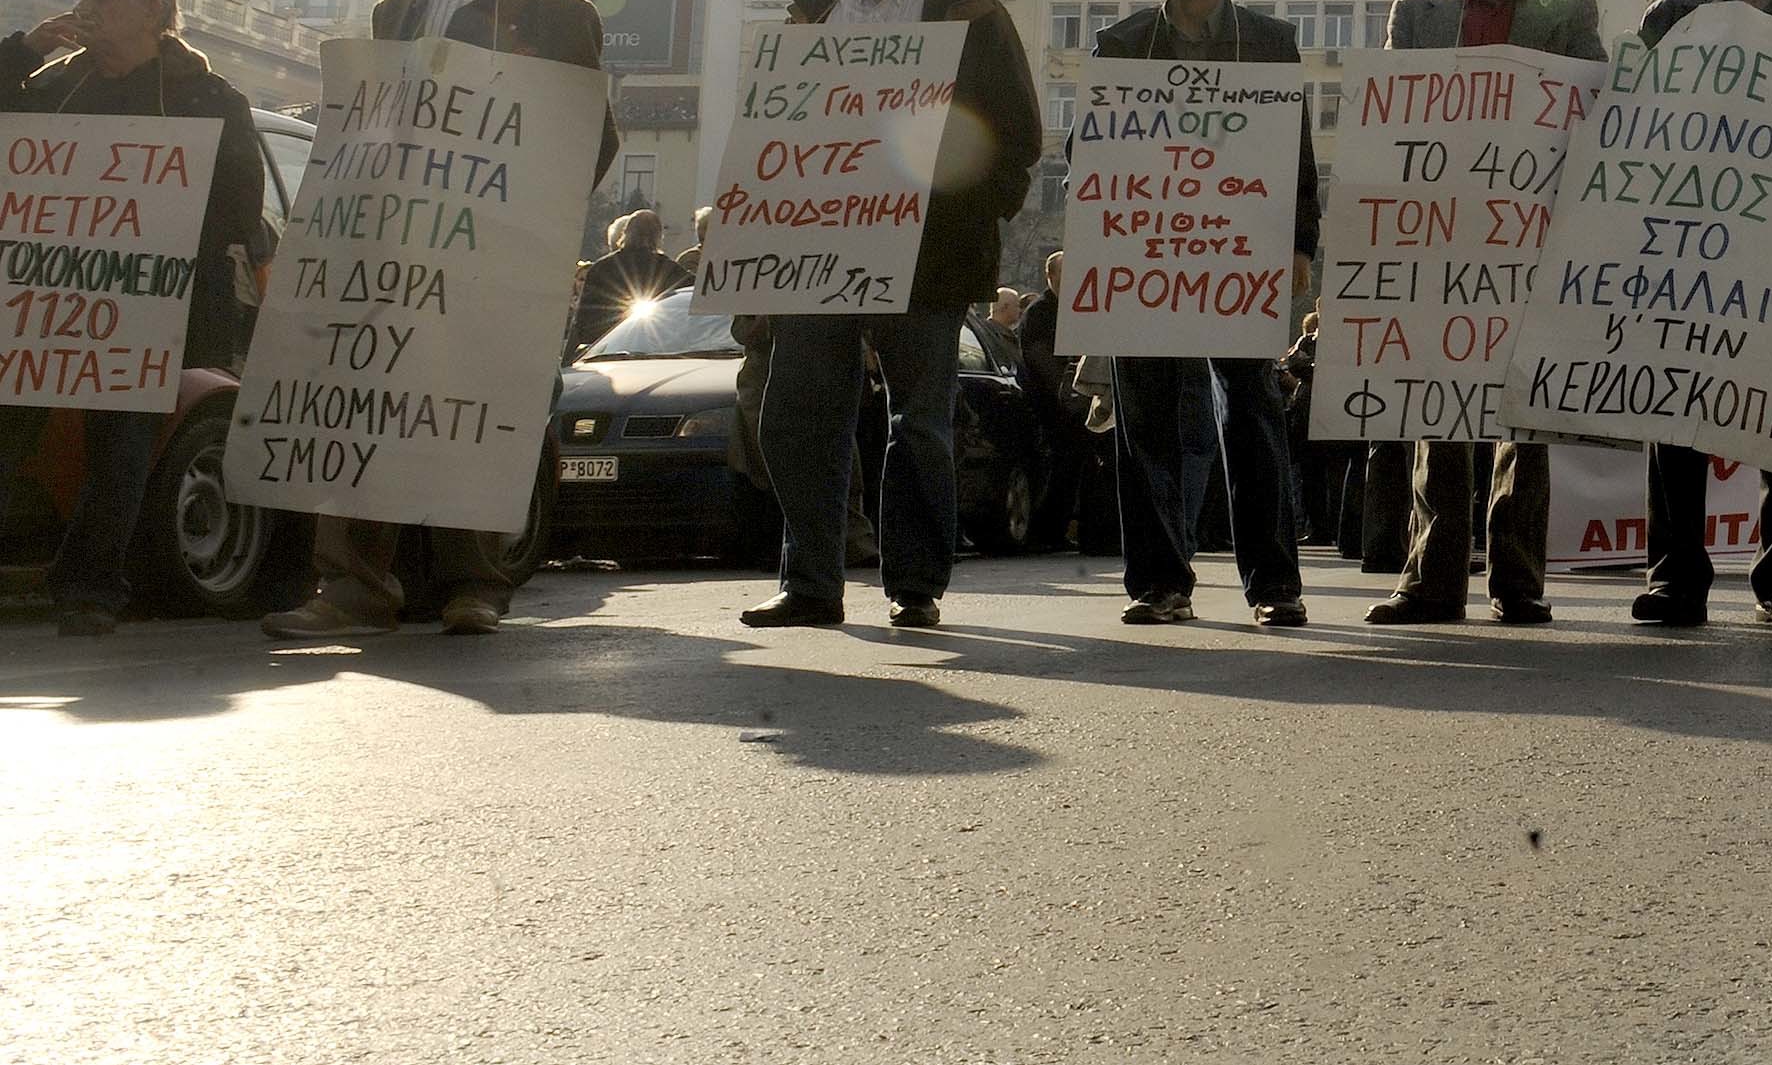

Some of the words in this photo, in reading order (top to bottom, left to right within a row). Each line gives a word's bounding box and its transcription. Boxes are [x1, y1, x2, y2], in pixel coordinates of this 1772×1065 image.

[603, 32, 640, 46] ome
[754, 34, 782, 72] Η
[800, 35, 924, 67] ΑΥΞΗΣΗ
[1090, 86, 1174, 106] ΣΤΟΝ
[1185, 87, 1304, 104] ΣΤΗΜΕΝΟ
[1167, 64, 1221, 87] ΟΧΙ
[742, 81, 821, 121] 1.5%
[824, 85, 864, 116] ΓΙΑ
[1361, 72, 1514, 126] ΝΤΡΟΠΗ
[1534, 80, 1600, 130] ΣΑ
[1079, 110, 1248, 141] ΔΙΑΛΟΓΟ
[9, 138, 78, 176] ΟΧΙ
[100, 143, 188, 187] ΣΤΑ
[757, 139, 882, 181] ΟΥΤΕ
[1164, 146, 1215, 171] ΤΟ
[1394, 141, 1447, 182] ΤΟ
[1077, 173, 1201, 201] ΔΙΚΙΟ
[1218, 177, 1268, 197] ΘΑ
[0, 191, 141, 237] ΜΕΤΡΑ
[1103, 210, 1231, 237] ΚΡΙΘΗ
[1359, 197, 1456, 246] ΤΩΝ
[1145, 236, 1252, 258] ΣΤΟΥΣ
[1639, 217, 1730, 260] ΣΤΟ
[296, 258, 327, 298] ΤΑ
[701, 253, 839, 296] ΝΤΡΟΠΗ
[820, 267, 894, 307] ΣΑΣ
[1071, 266, 1285, 319] ΔΡΟΜΟΥΣ
[1336, 261, 1418, 302] ΖΕΙ
[6, 290, 119, 340] 1120
[327, 323, 415, 374] ΤΟΥ
[1343, 317, 1411, 367] ΤΑ
[1442, 315, 1509, 362] ΟΡ
[1653, 318, 1747, 359] ΤΗΝ
[0, 347, 170, 396] ΥΝΤΑΞΗ
[1344, 379, 1536, 441] ΦΤΩΧΕ
[259, 437, 377, 488] ΣΜΟΥ
